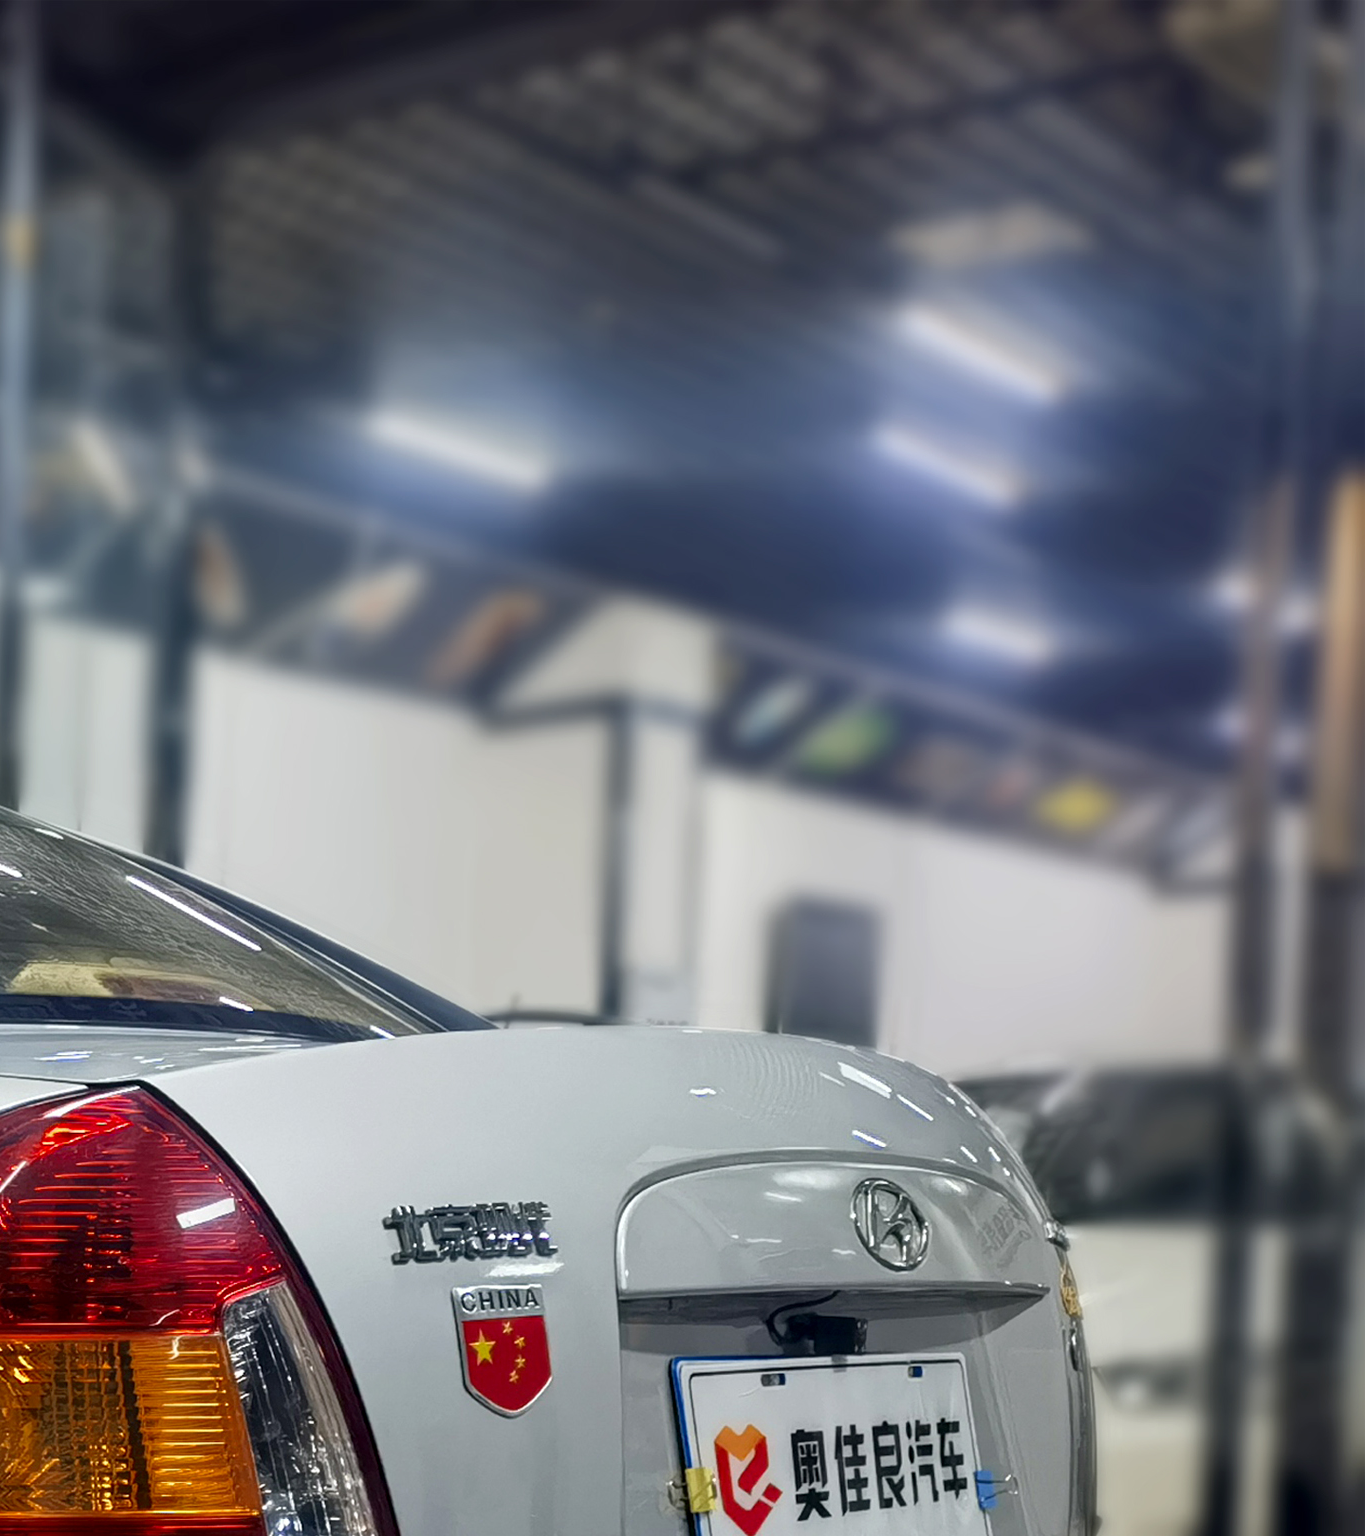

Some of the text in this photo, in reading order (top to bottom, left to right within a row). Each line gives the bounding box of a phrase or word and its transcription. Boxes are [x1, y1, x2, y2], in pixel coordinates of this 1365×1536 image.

[460, 1288, 541, 1313] CHINA
[790, 1417, 968, 1522] 奥佳良汽车
